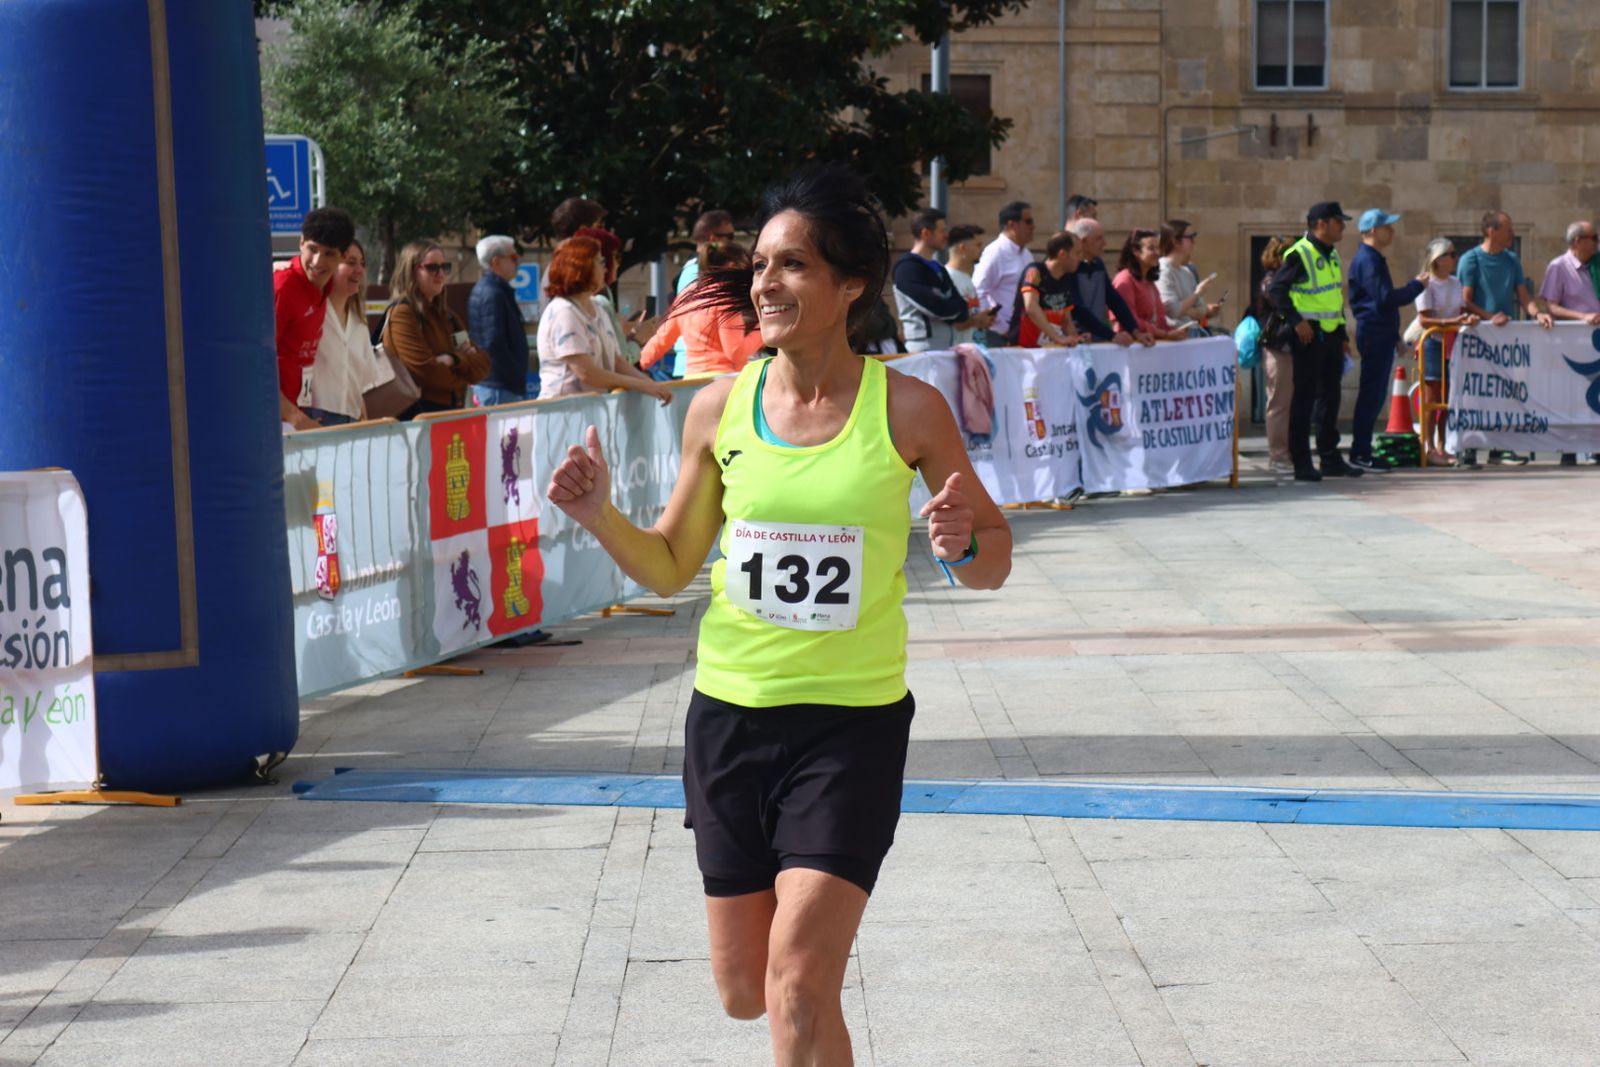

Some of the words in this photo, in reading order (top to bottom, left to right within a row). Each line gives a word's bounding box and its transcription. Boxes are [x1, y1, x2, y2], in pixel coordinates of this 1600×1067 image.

[1138, 365, 1217, 394] FEDERACIÓN
[1142, 428, 1157, 449] DE
[1215, 415, 1234, 441] LEÓ
[1447, 408, 1502, 433] CASTILLA
[1504, 411, 1513, 432] Y
[1515, 410, 1549, 434] LEÓN
[736, 527, 752, 538] DÍA
[754, 530, 767, 540] DE
[769, 531, 817, 543] CASTILLA
[819, 534, 826, 543] Y
[828, 532, 856, 544] LEÓN
[0, 546, 71, 612] na
[740, 552, 851, 604] 132
[366, 593, 402, 626] León
[0, 615, 70, 670] sión
[0, 690, 16, 725] a
[46, 684, 86, 725] eón
